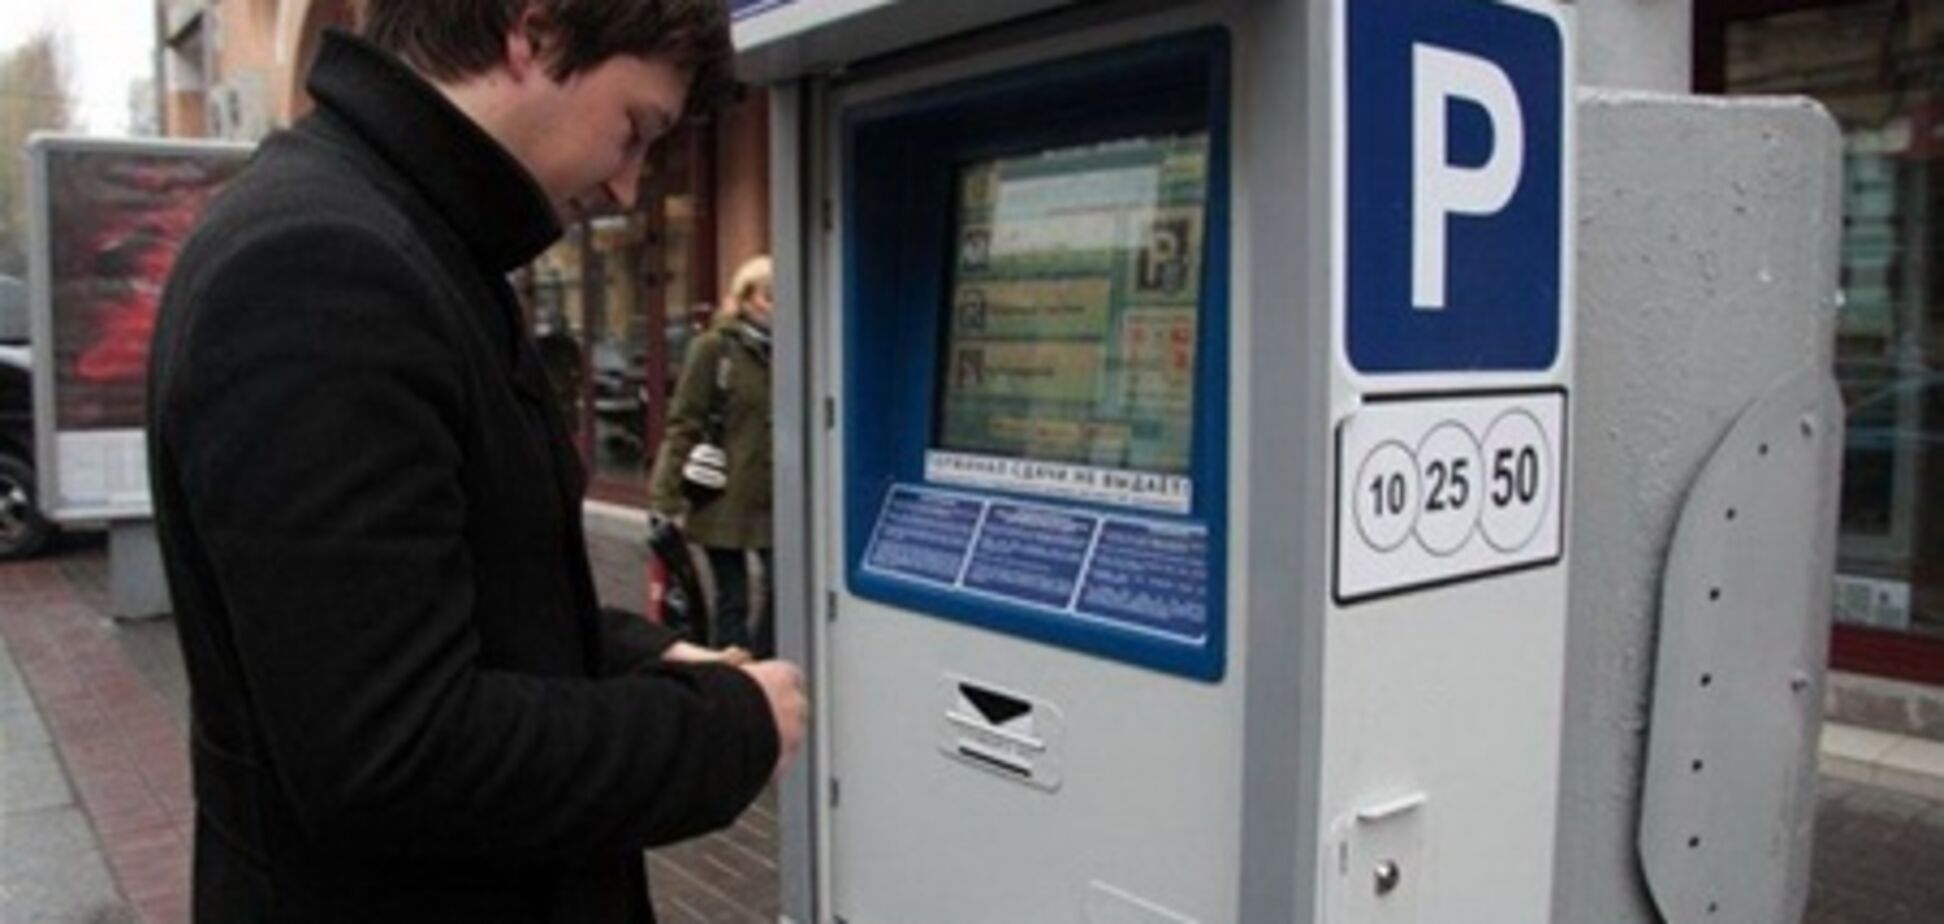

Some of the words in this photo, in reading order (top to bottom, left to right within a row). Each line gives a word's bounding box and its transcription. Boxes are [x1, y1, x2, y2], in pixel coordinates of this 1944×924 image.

[1412, 42, 1525, 309] P
[1010, 459, 1068, 481] СДАЧИ
[1074, 468, 1095, 486] НЕ
[1370, 472, 1406, 517] 10
[1425, 458, 1469, 514] 25
[1492, 446, 1539, 507] 50
